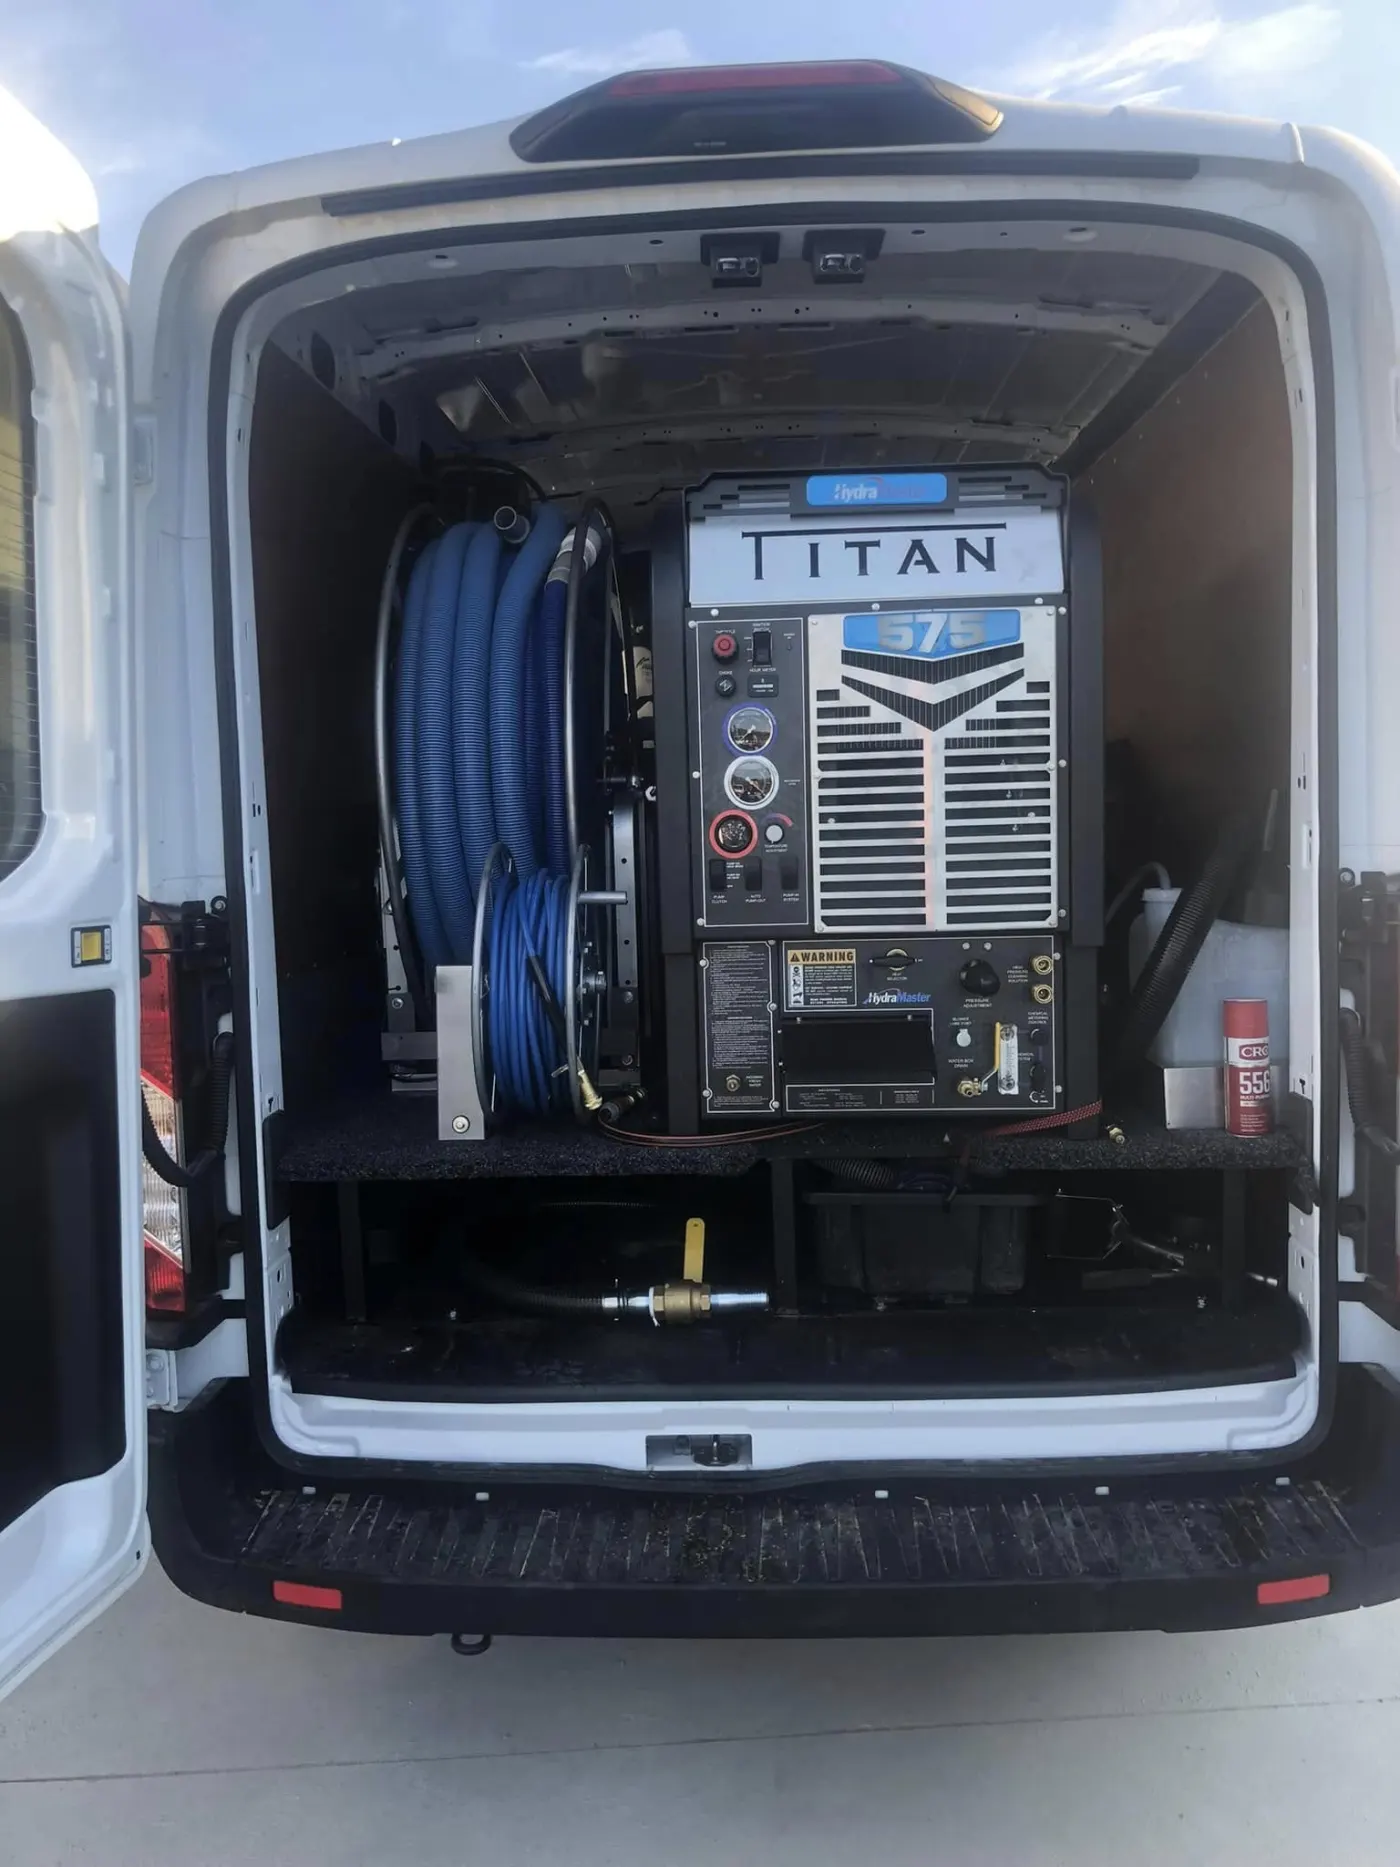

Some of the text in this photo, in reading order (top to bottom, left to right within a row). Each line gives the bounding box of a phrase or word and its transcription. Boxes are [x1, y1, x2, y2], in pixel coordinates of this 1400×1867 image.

[742, 522, 1006, 580] TITAN
[878, 612, 986, 653] 575
[801, 952, 854, 962] WARNING
[1239, 1070, 1270, 1094] 556
